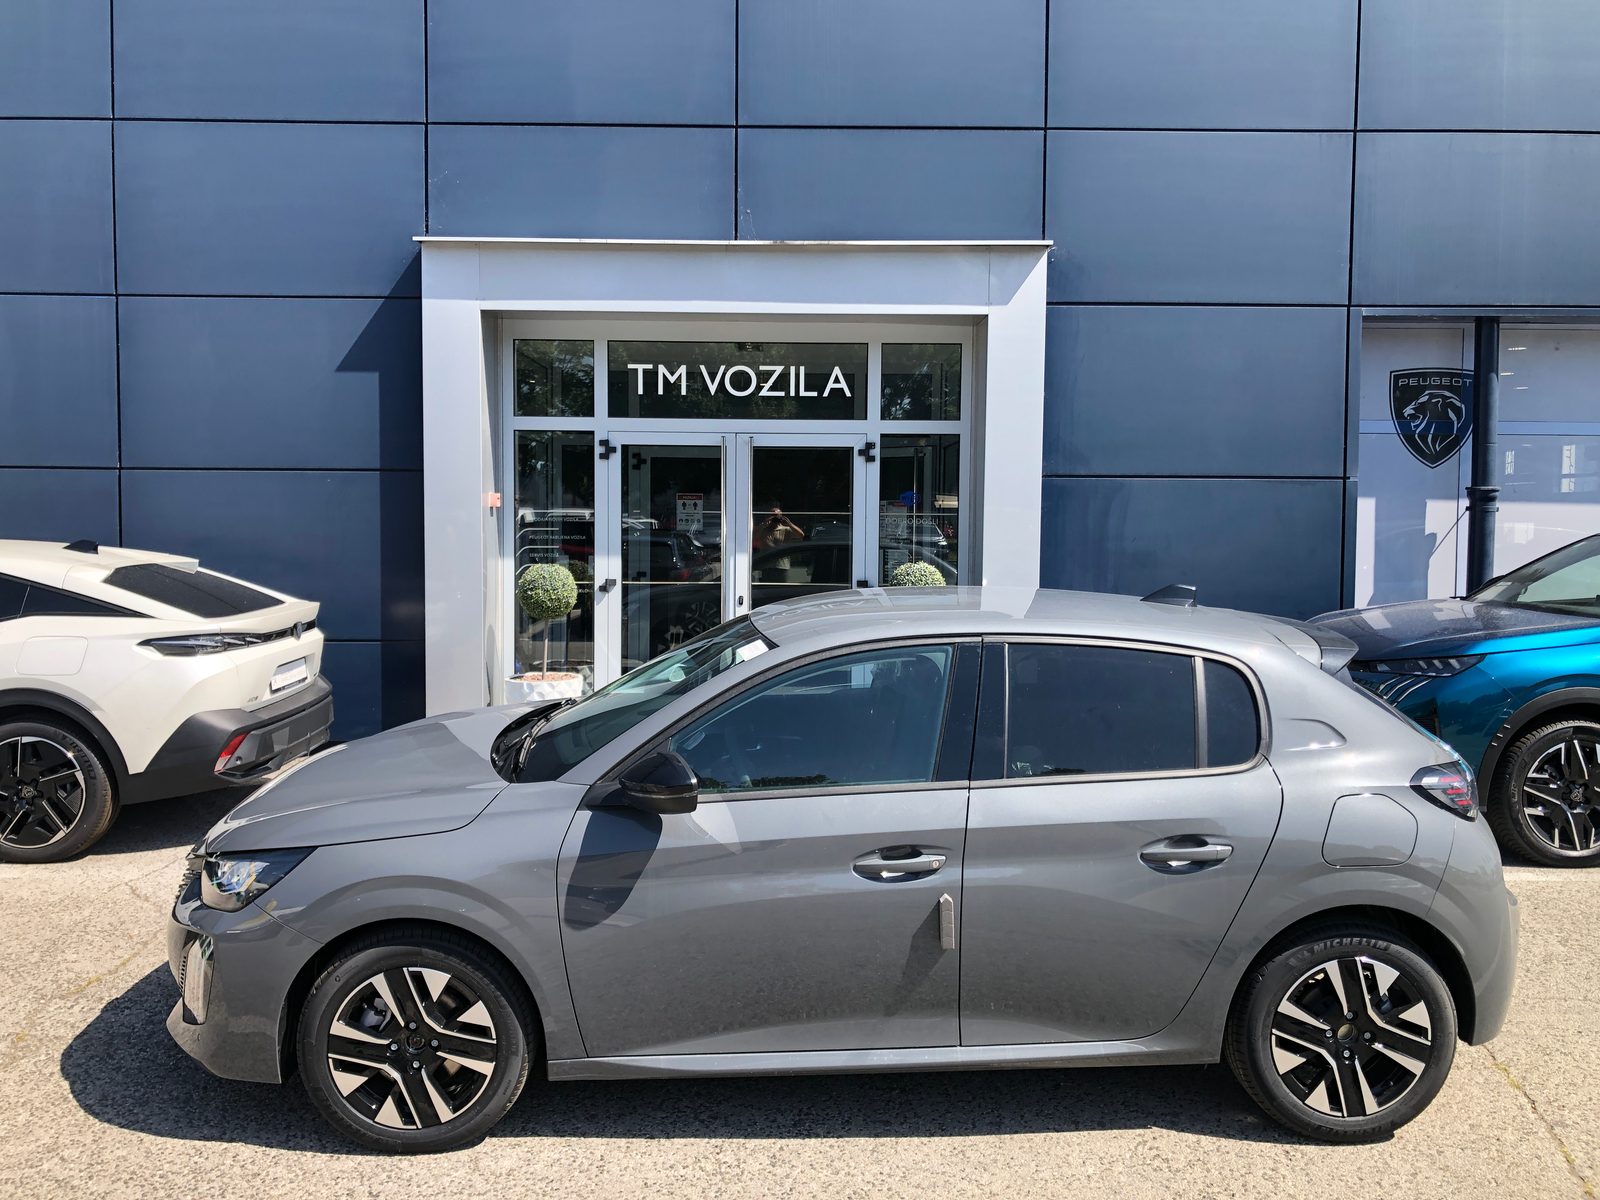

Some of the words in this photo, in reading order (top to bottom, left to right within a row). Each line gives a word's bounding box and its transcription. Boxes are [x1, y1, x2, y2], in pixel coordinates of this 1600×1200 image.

[627, 363, 687, 396] TM
[699, 364, 852, 398] VOZILA
[1398, 377, 1473, 387] PEUGEOT
[1313, 937, 1387, 953] MICHELIN
